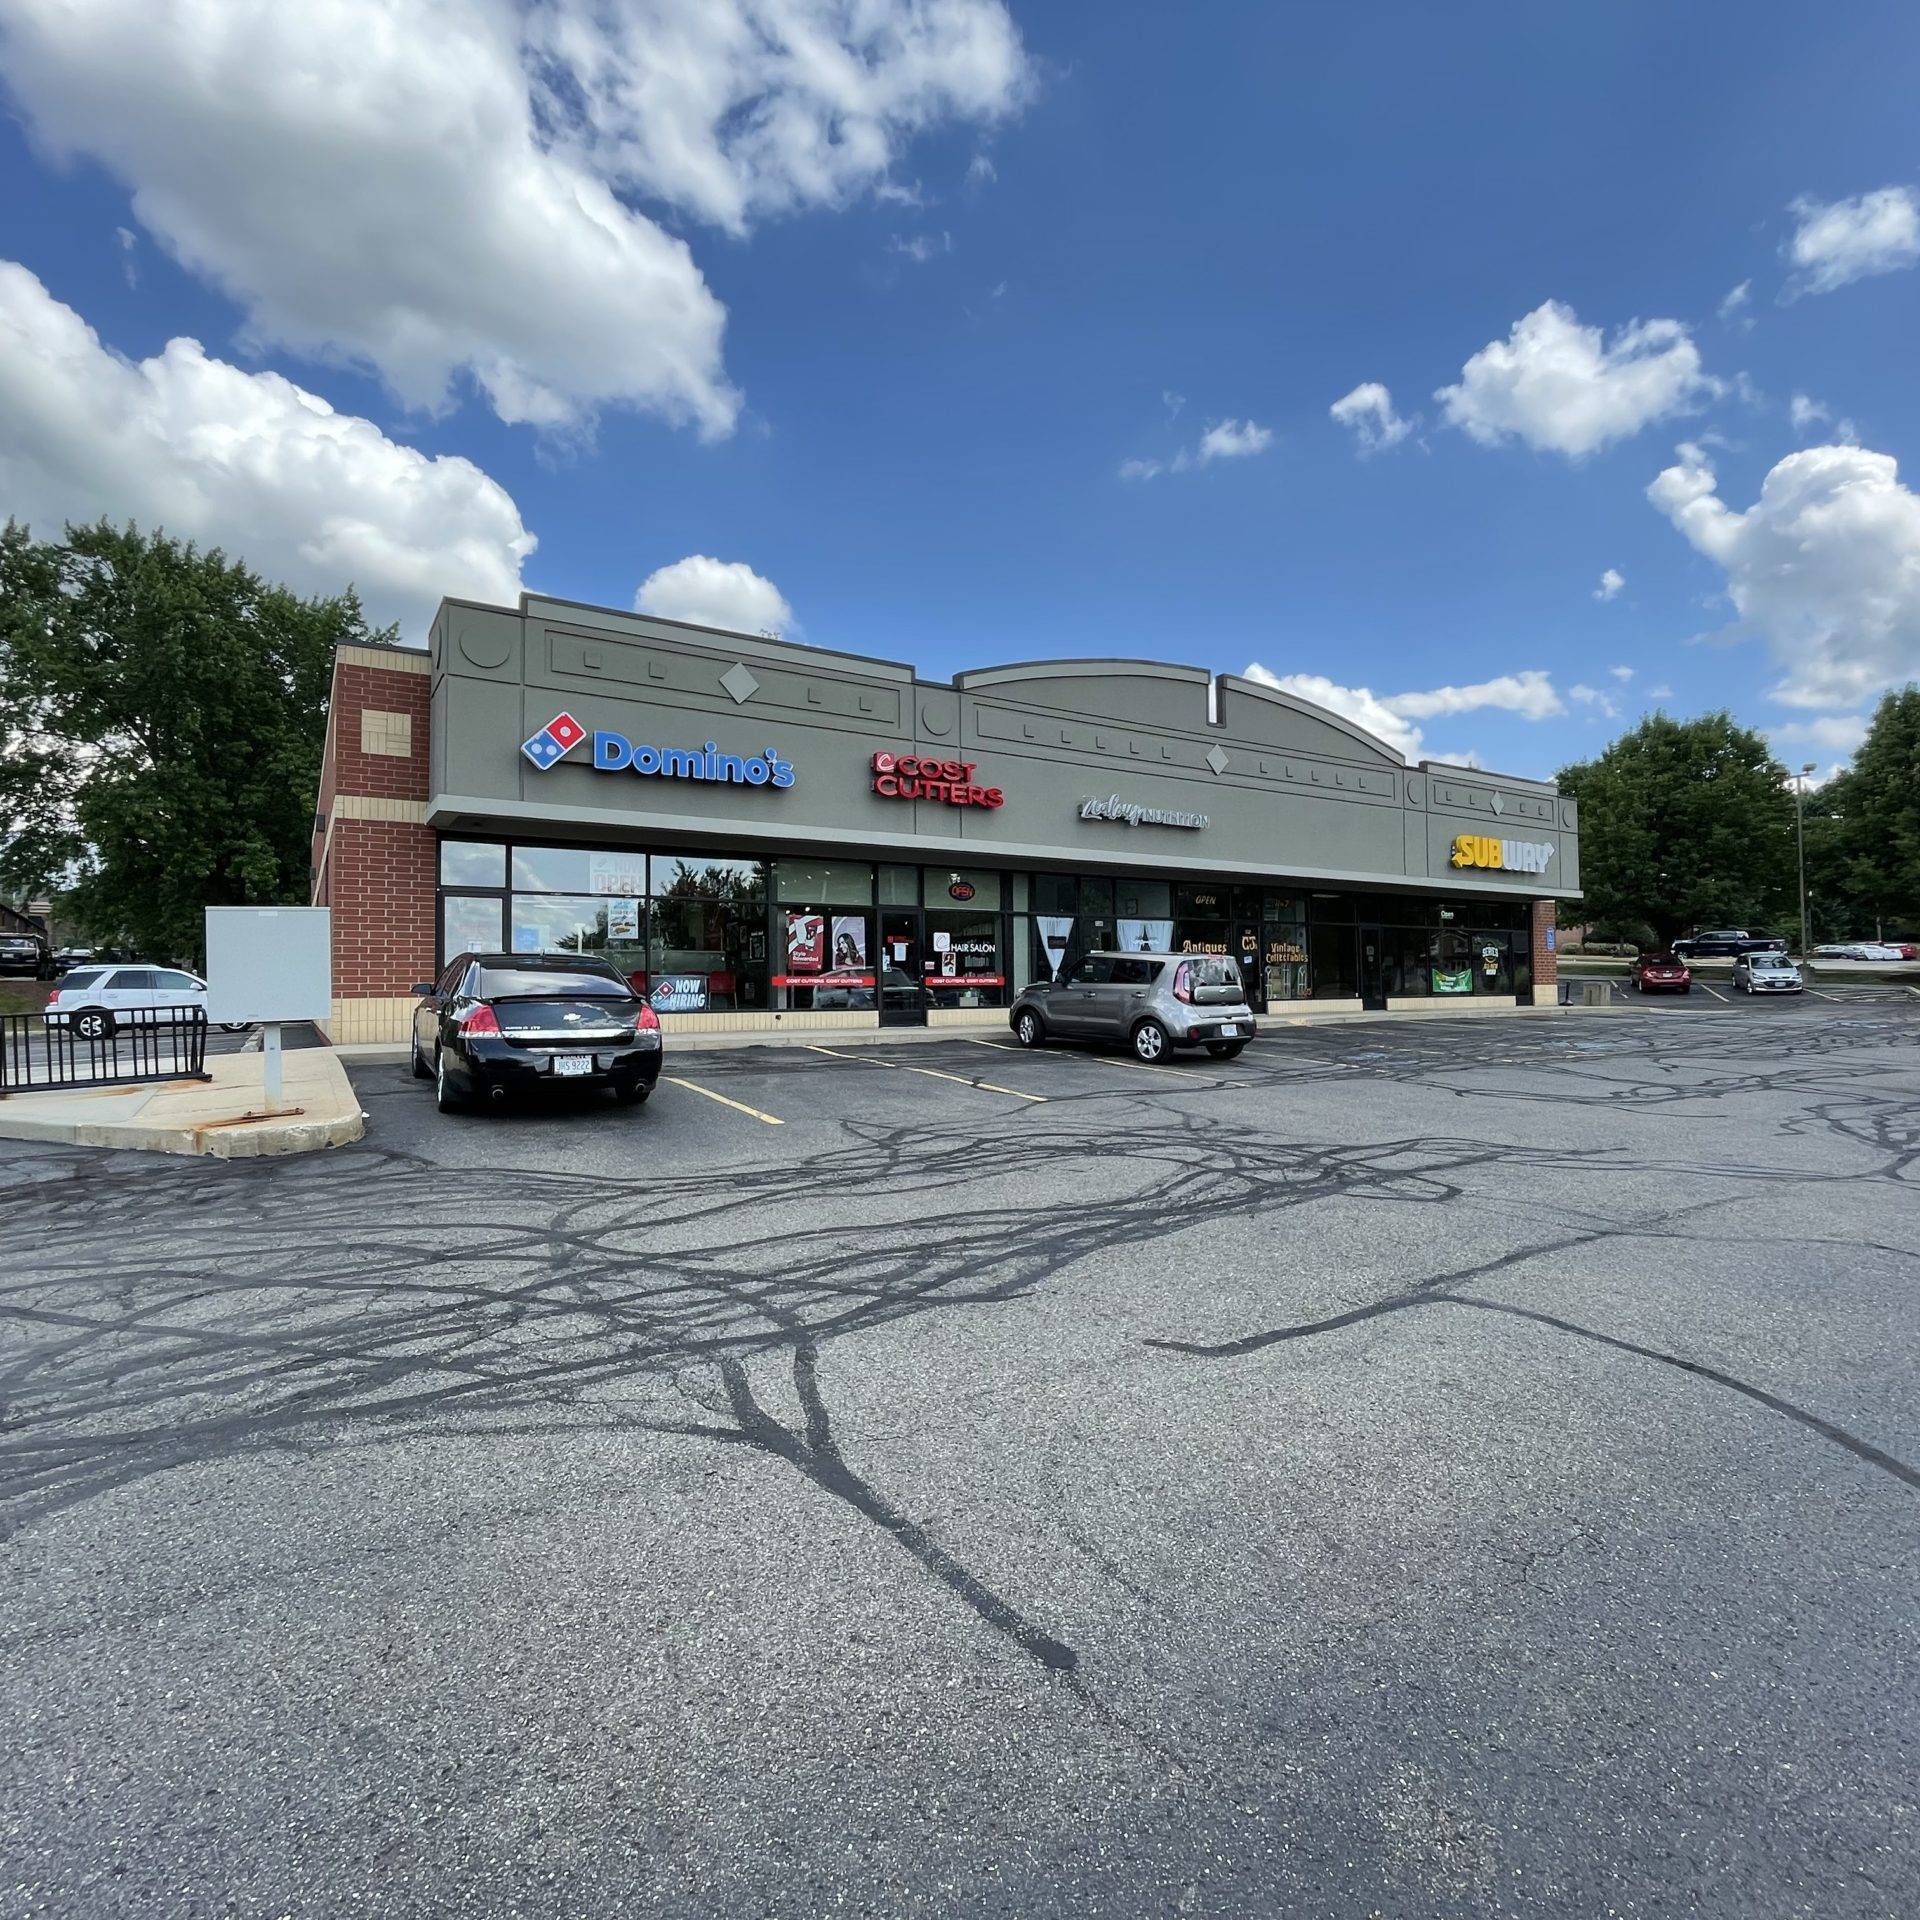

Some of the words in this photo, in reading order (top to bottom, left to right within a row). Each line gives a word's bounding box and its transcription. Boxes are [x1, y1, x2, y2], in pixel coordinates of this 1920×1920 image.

[593, 730, 795, 788] Domino's
[896, 755, 978, 782] COST
[876, 774, 1004, 809] CUTTERS
[1142, 808, 1210, 828] NUTRITION
[1453, 835, 1555, 873] SUBWAY
[1195, 895, 1216, 905] OPEN
[951, 943, 969, 952] HAIR
[970, 943, 996, 953] SALON
[1183, 940, 1227, 955] Antiques
[1271, 943, 1301, 955] Vintage
[675, 980, 700, 993] NOW
[669, 994, 706, 1007] HIRING
